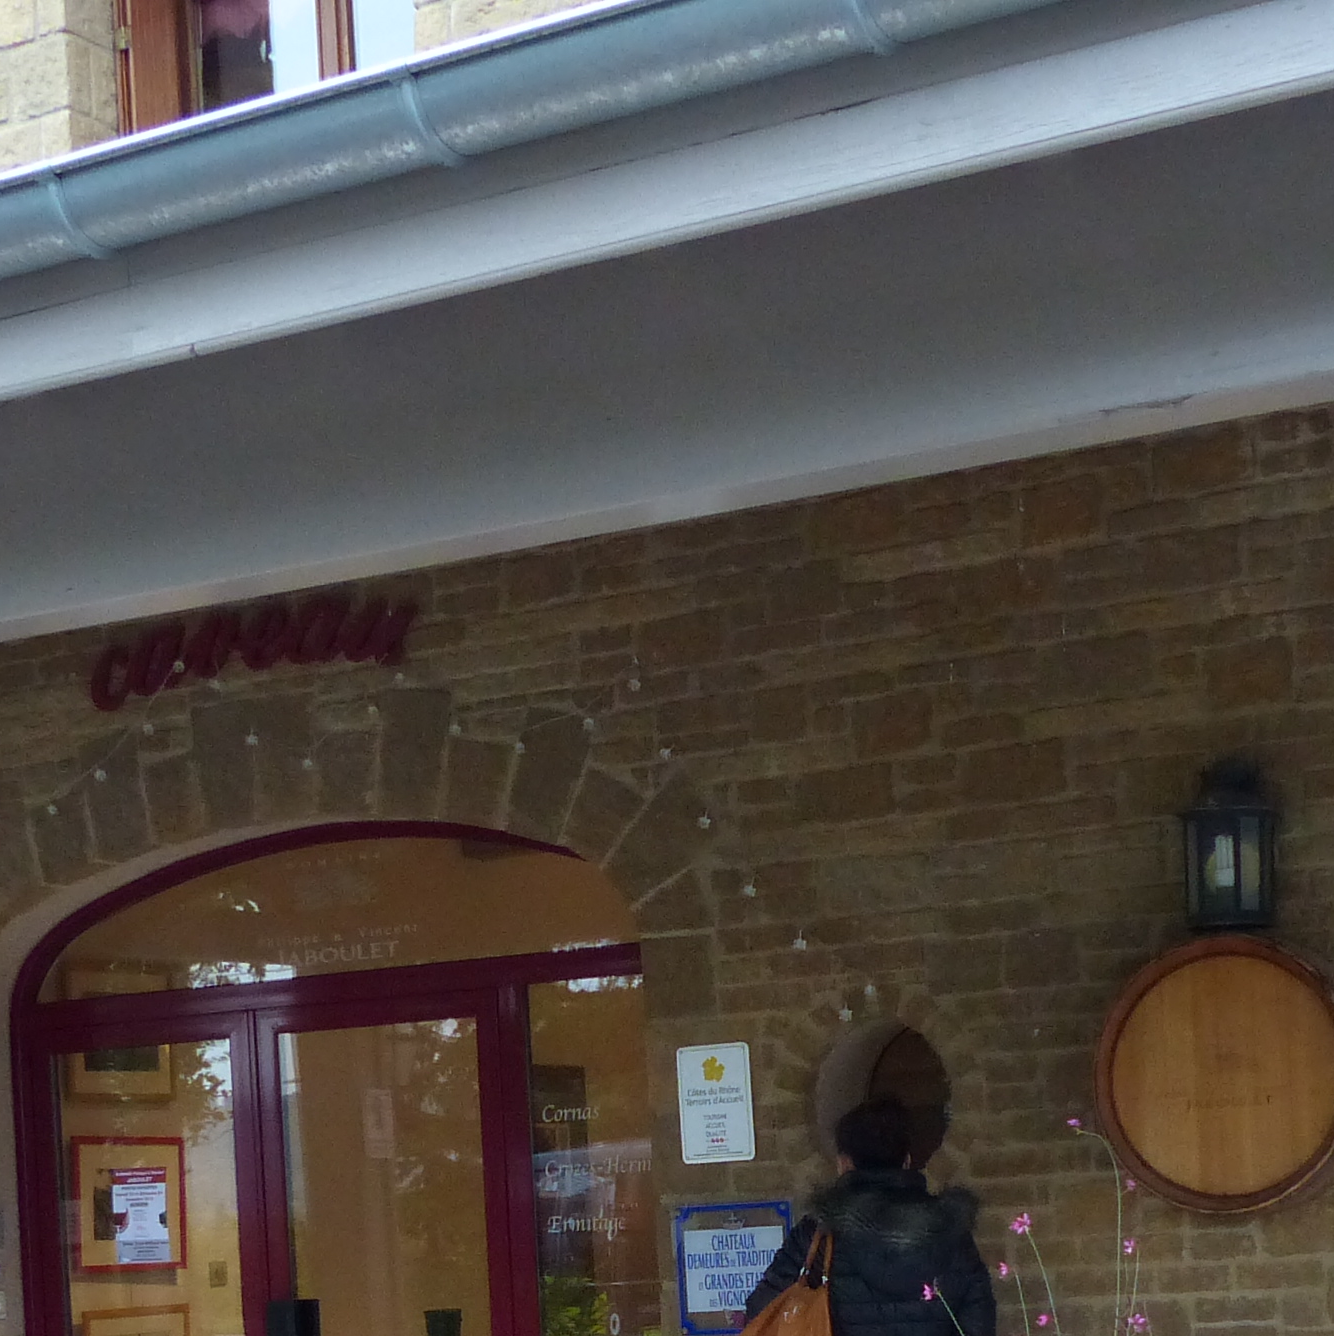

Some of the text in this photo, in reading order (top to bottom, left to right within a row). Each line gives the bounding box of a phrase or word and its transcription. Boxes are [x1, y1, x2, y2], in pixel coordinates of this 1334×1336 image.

[278, 940, 400, 968] JABOULET
[542, 1104, 600, 1122] Cornas
[545, 1155, 652, 1177] Crozes-Herm
[711, 1233, 755, 1251] CHATEAUX
[687, 1252, 729, 1269] DEMEURES
[737, 1249, 776, 1267] TRADITIO
[704, 1272, 744, 1290] GRANDES
